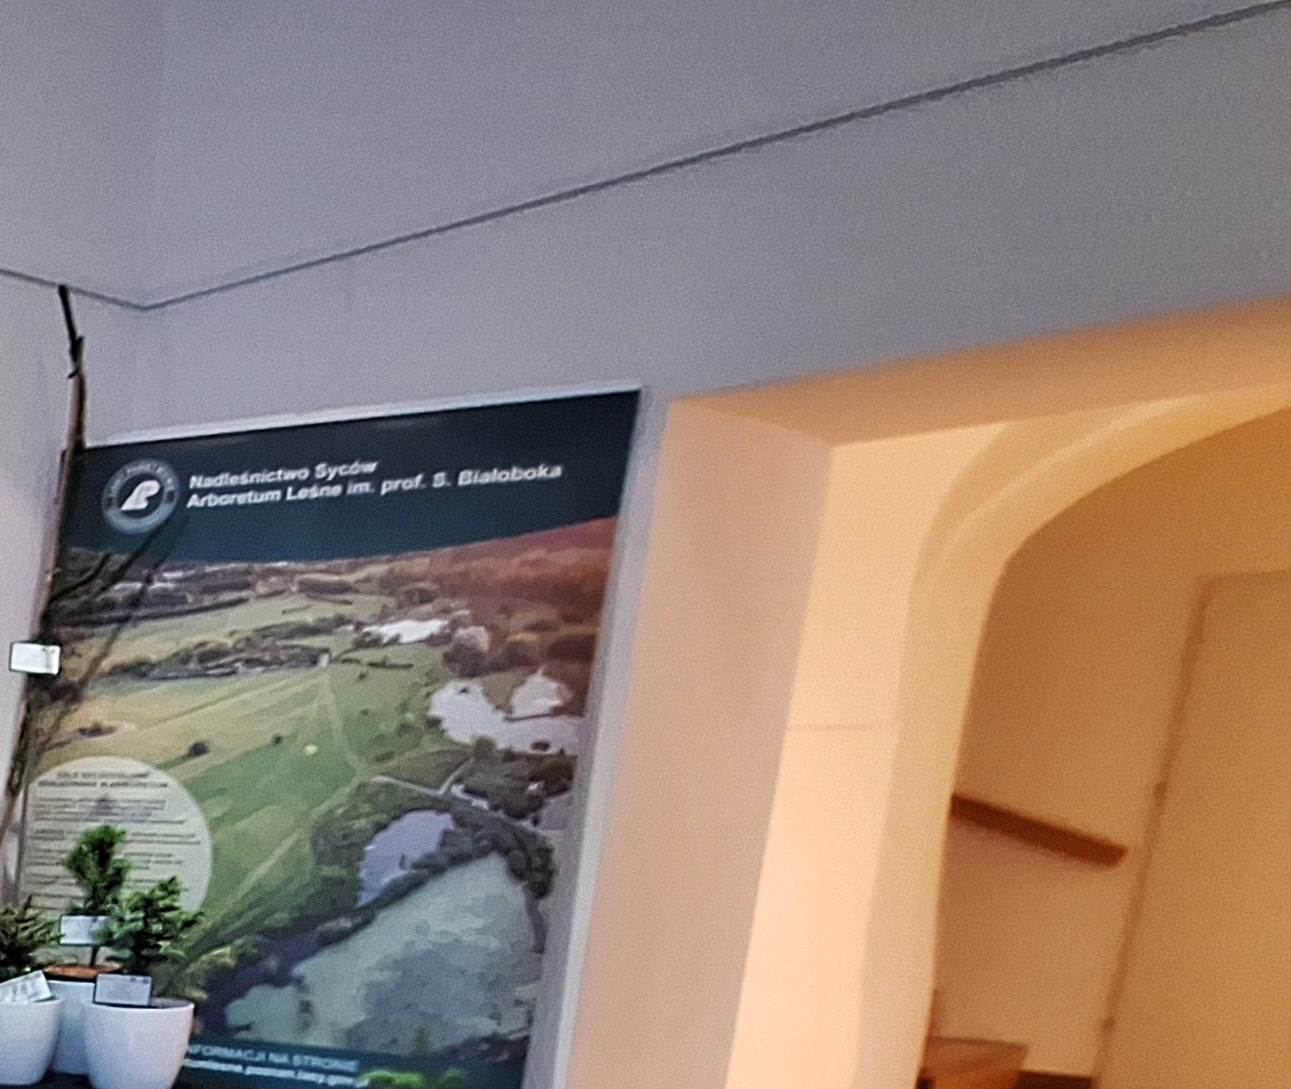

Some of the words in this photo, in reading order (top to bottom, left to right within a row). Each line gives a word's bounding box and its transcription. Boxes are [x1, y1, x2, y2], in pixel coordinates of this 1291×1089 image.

[188, 467, 309, 489] Nadleśnictwo
[314, 460, 378, 480] Syców
[186, 489, 282, 508] Arboretum
[286, 482, 343, 501] Leśne
[347, 480, 374, 495] im.
[380, 473, 426, 496] prof.
[432, 471, 452, 488] S.
[187, 1043, 267, 1062] NFORMACJI
